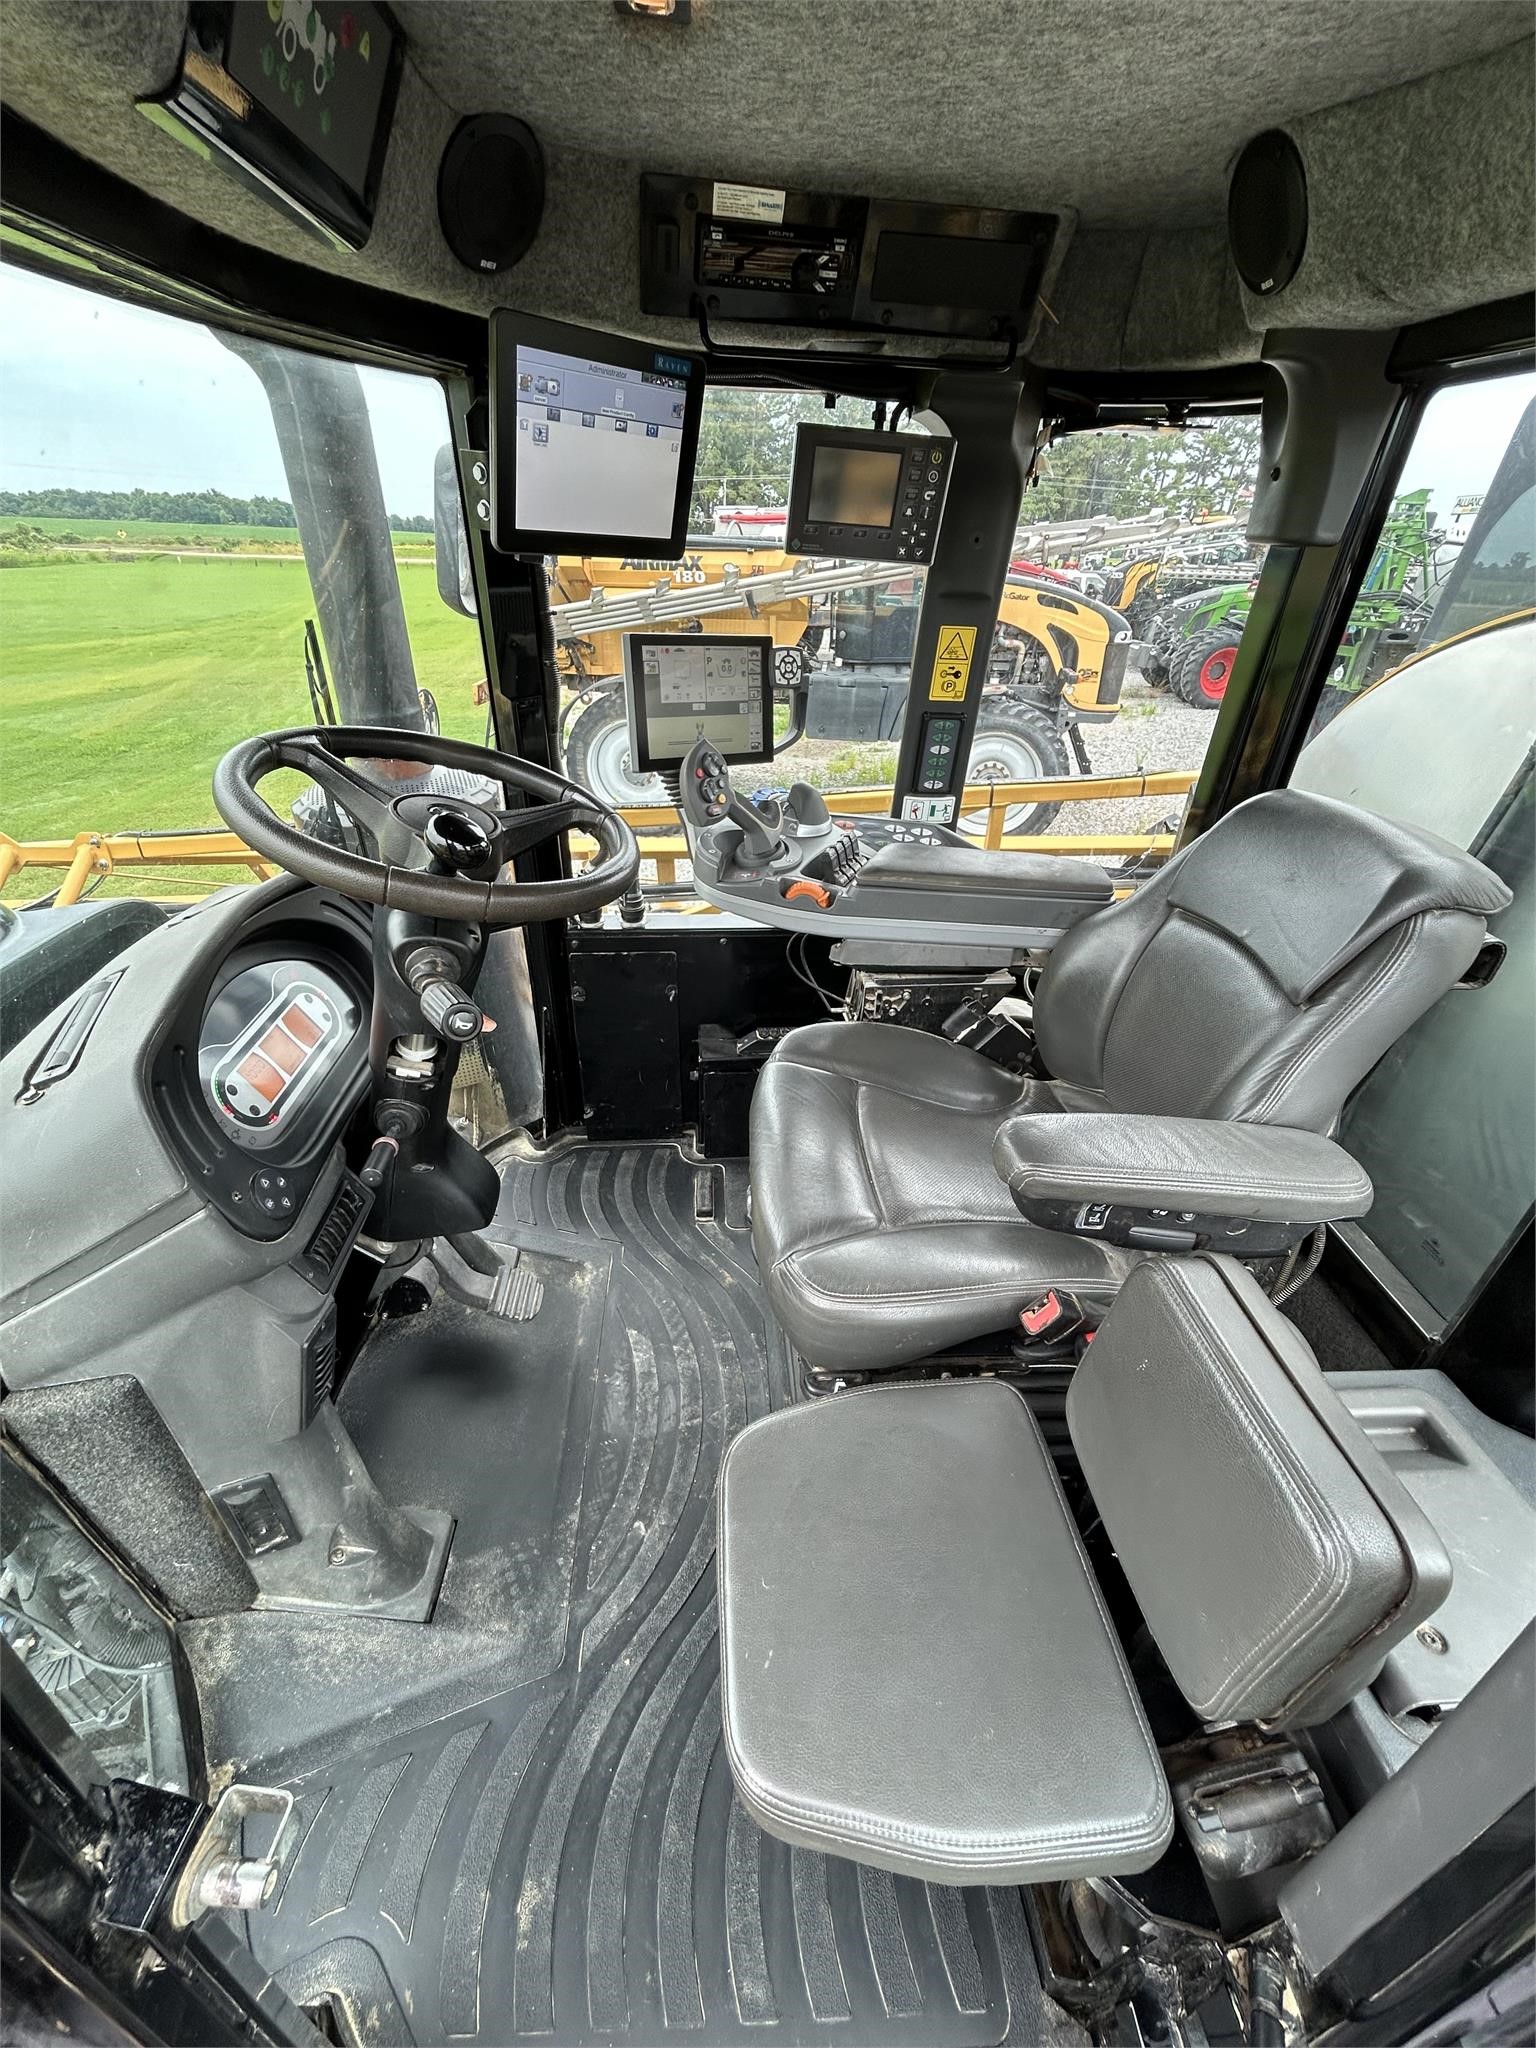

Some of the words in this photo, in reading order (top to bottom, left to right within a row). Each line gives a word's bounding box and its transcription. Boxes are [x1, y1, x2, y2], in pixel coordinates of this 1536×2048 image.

[588, 364, 628, 379] Administrator
[657, 356, 690, 374] RAVEN
[1454, 497, 1486, 508] ALLIANC
[620, 555, 704, 571] AIRMAX
[673, 570, 706, 583] 180
